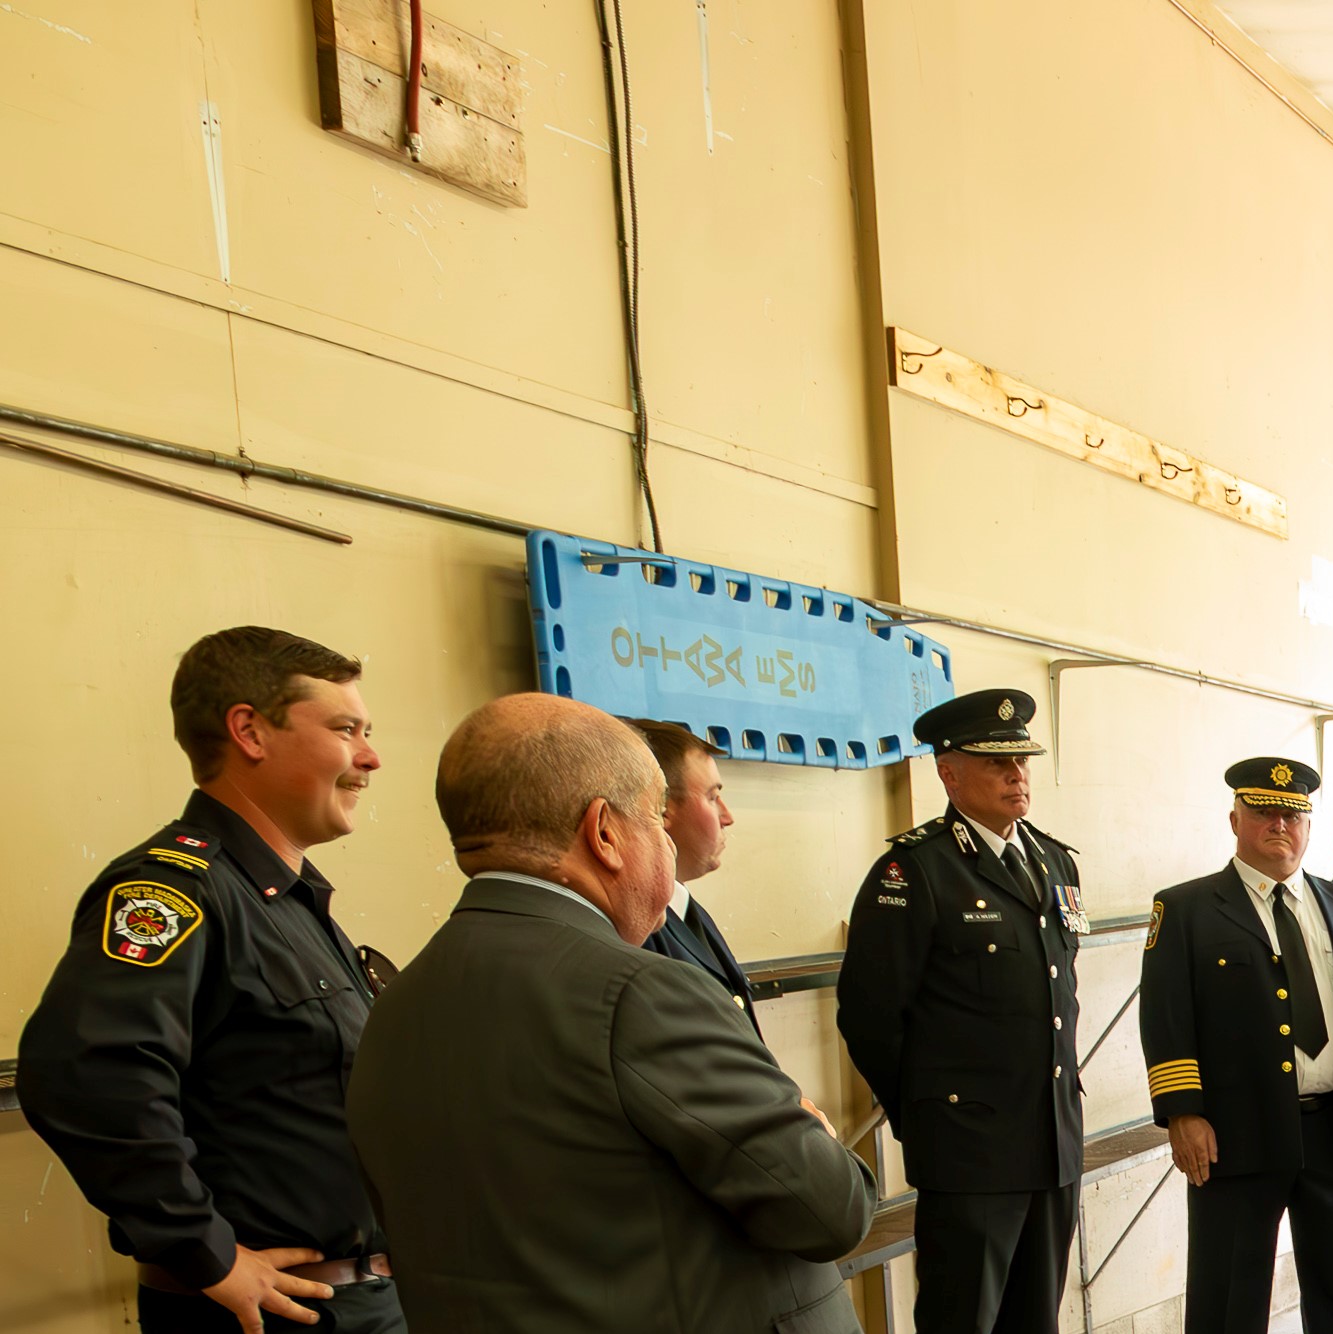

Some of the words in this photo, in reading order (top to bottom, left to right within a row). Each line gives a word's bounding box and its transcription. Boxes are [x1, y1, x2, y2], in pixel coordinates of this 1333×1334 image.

[611, 626, 746, 688] OTTAWA
[756, 649, 816, 698] EMS
[878, 895, 907, 907] ONTARIO
